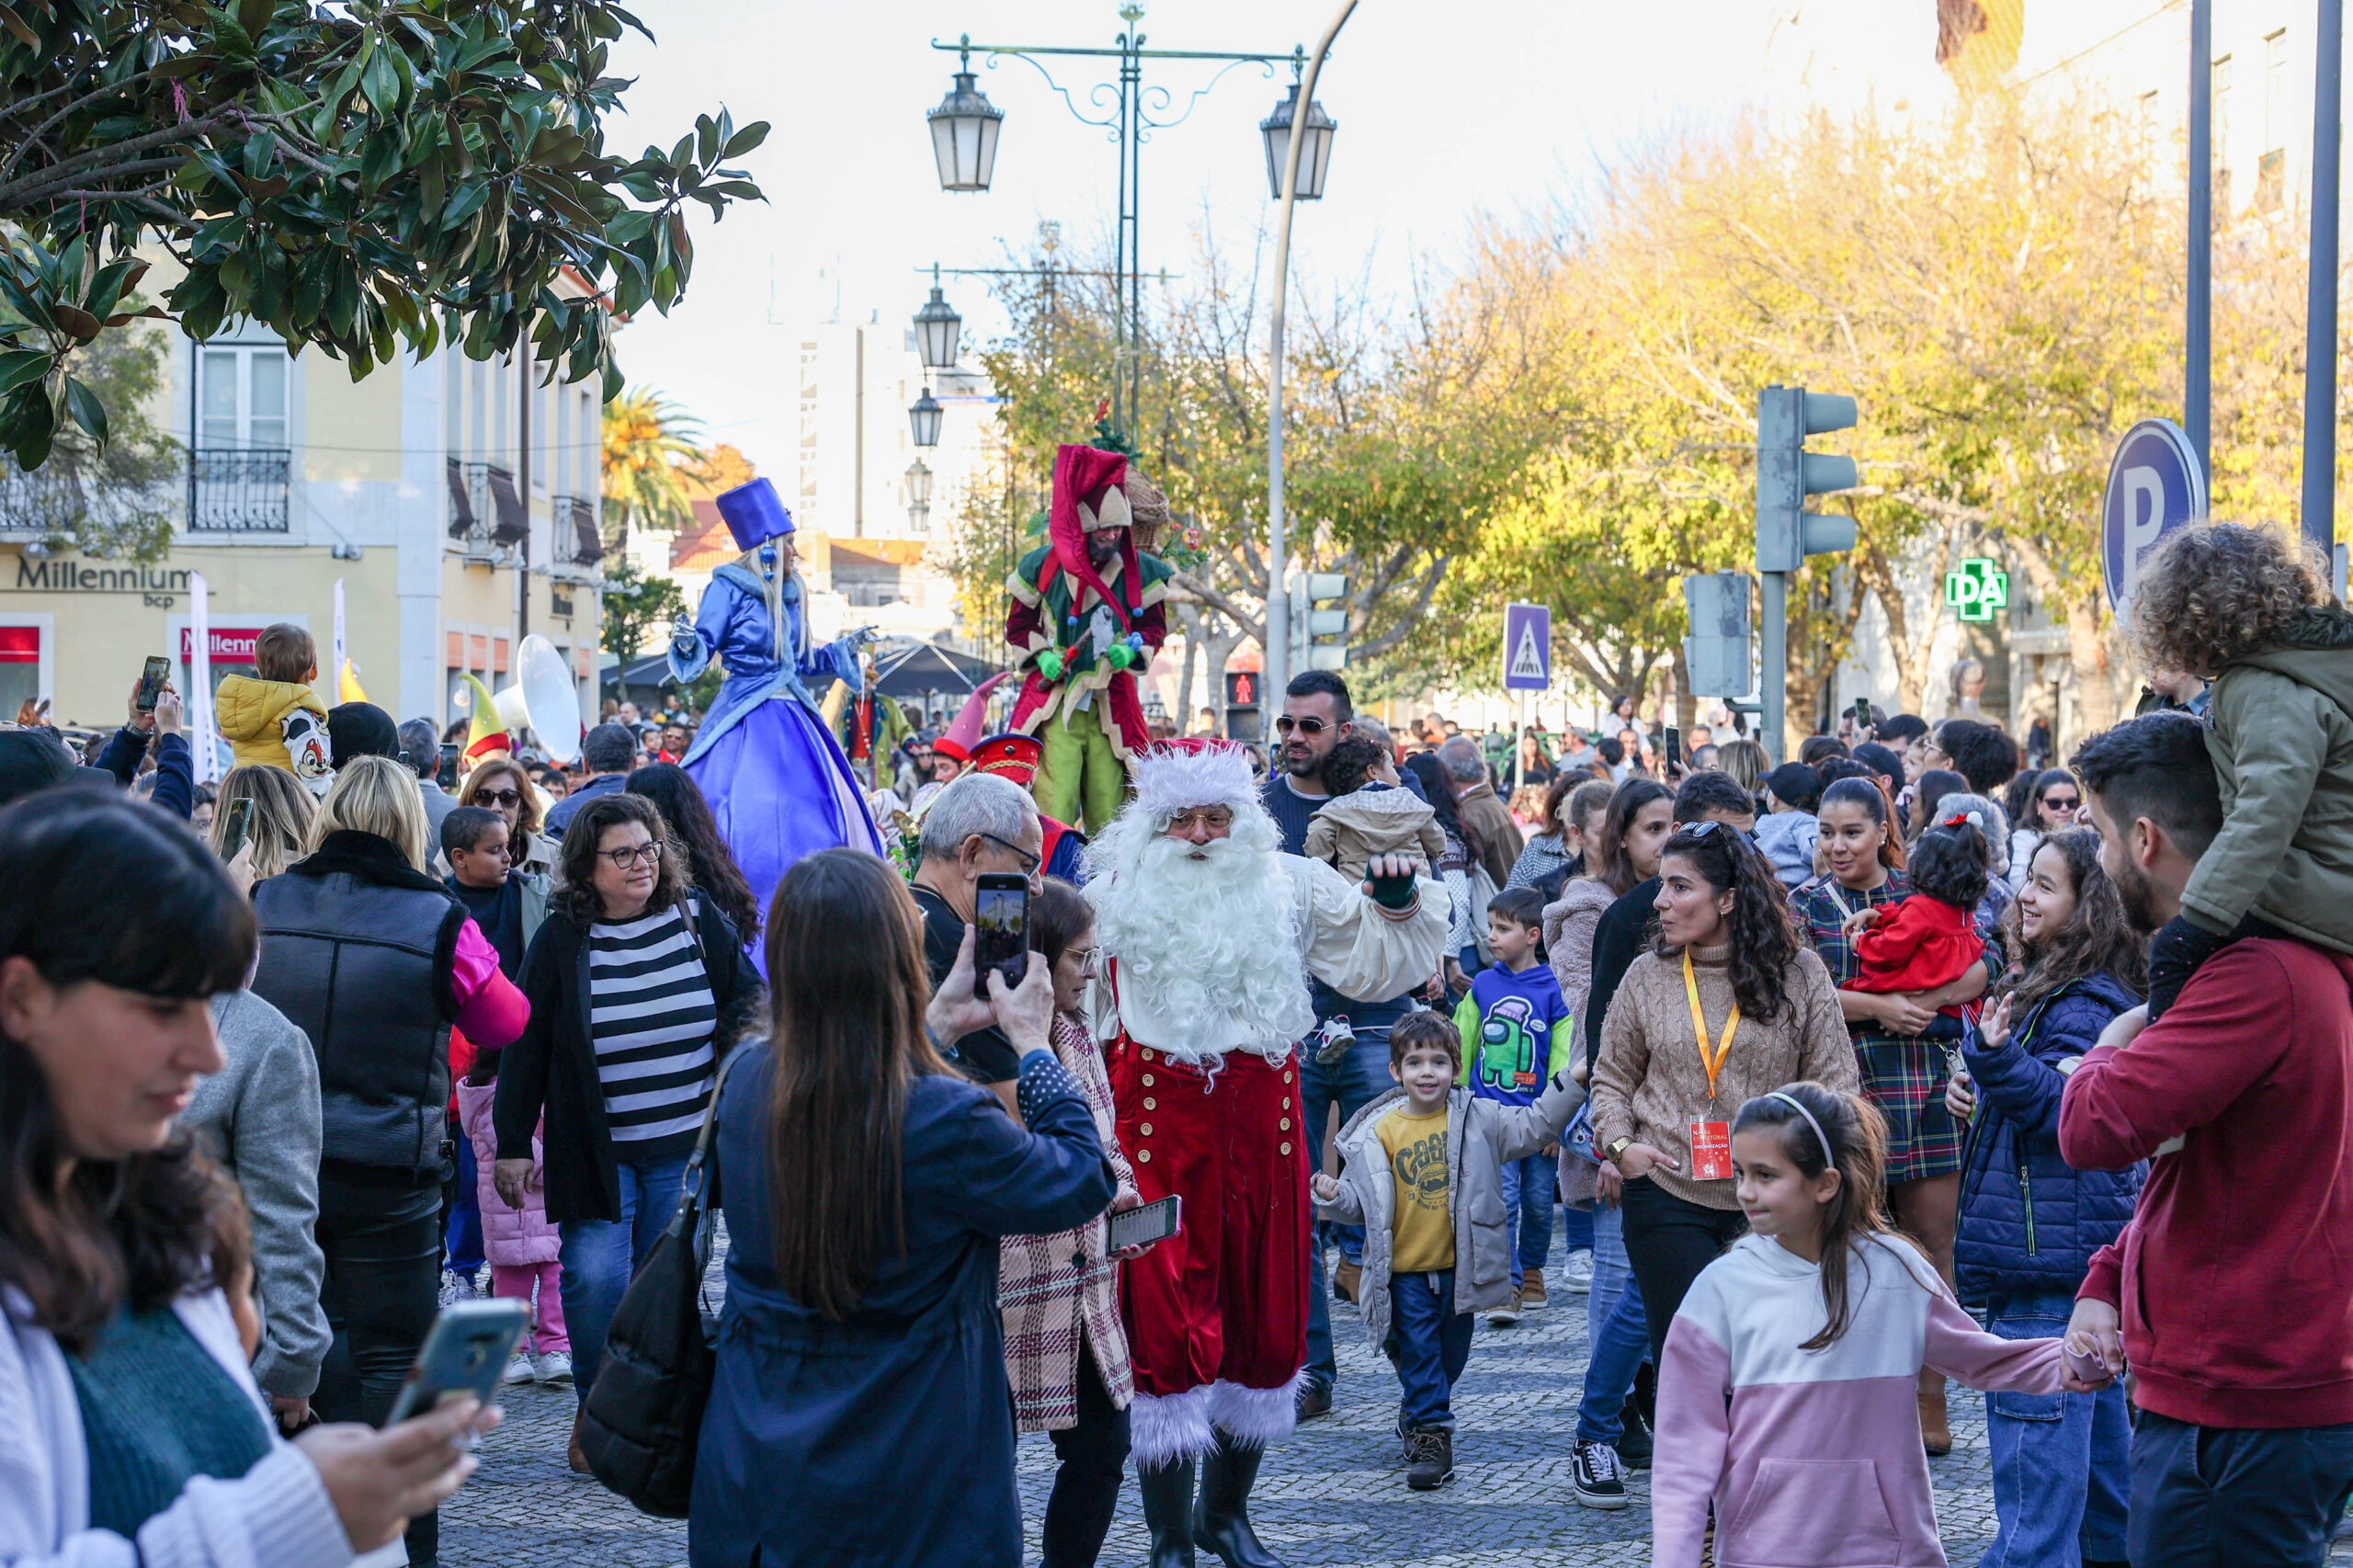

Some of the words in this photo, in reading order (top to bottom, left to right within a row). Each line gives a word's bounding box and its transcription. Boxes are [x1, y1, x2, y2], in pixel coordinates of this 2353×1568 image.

[2123, 465, 2165, 599] P
[17, 554, 192, 589] Millennium
[143, 592, 175, 610] bcp
[1957, 574, 2005, 604] DA
[184, 630, 256, 653] llenn
